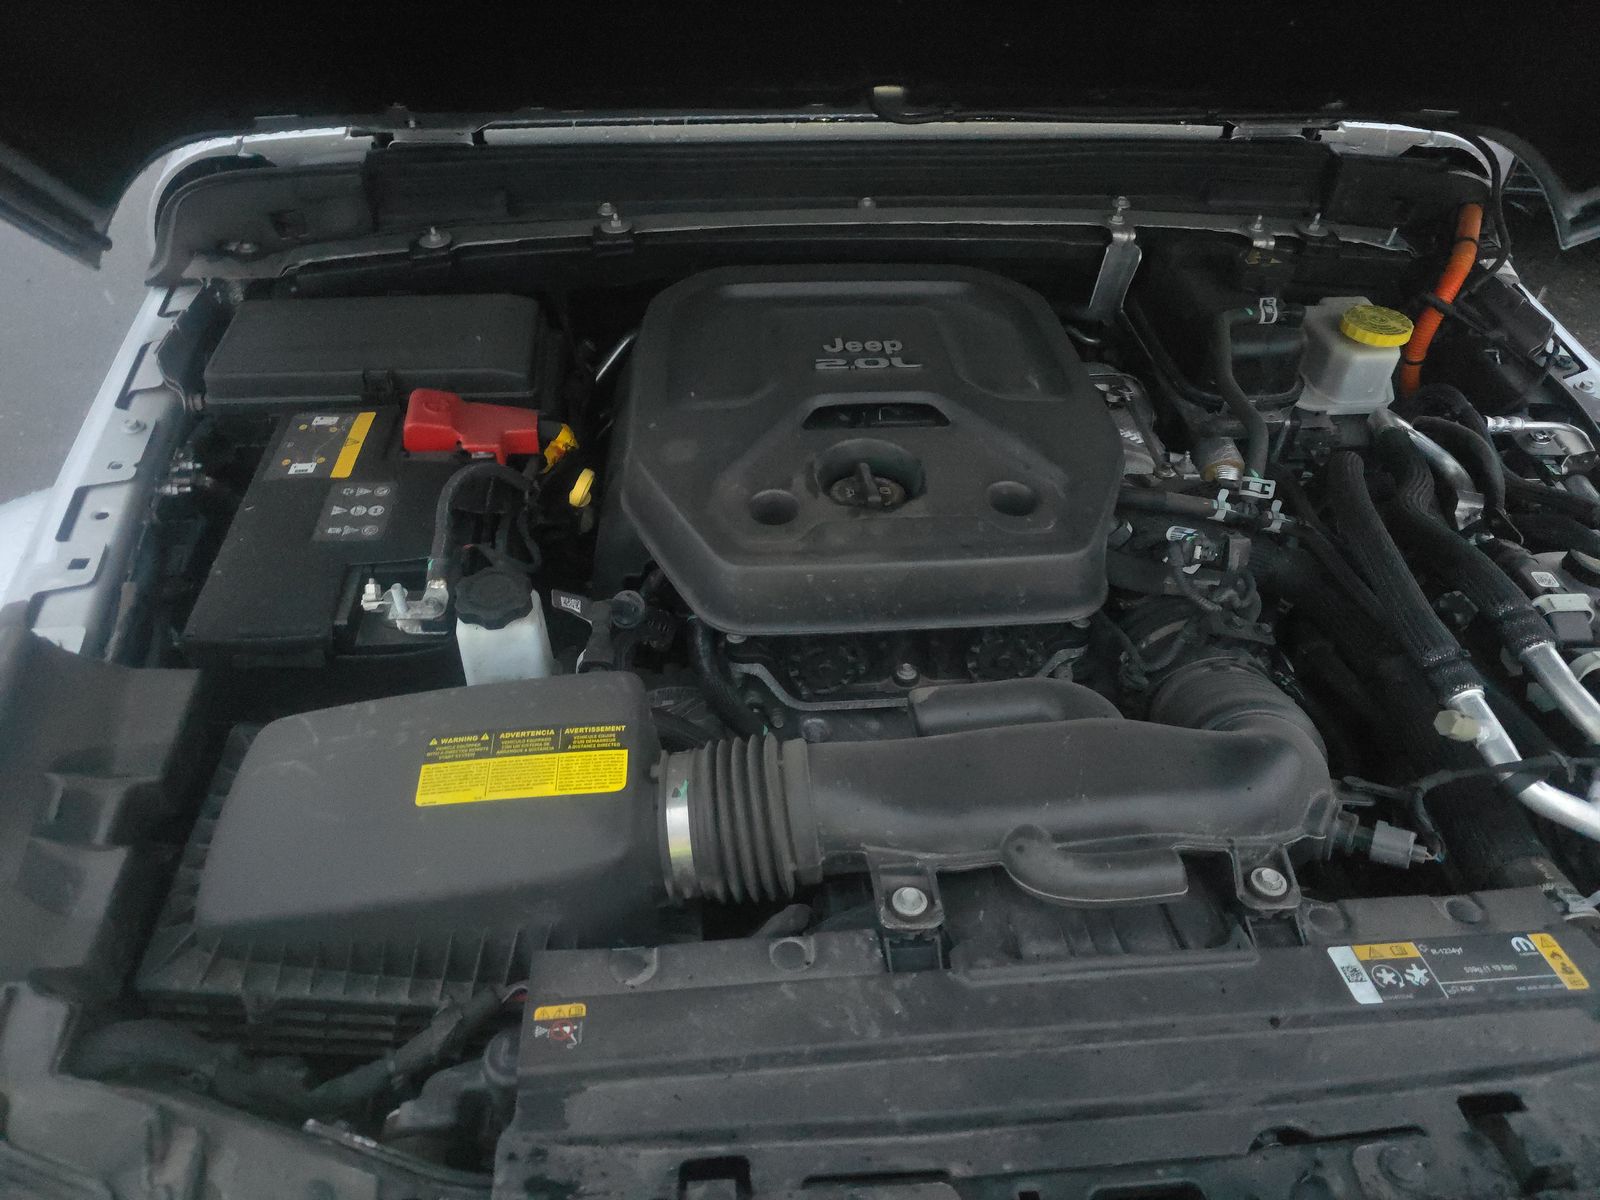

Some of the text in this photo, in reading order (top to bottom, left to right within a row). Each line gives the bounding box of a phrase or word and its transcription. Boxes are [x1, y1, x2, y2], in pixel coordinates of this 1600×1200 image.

[823, 337, 902, 354] Jeep
[815, 357, 923, 369] 2.0L
[500, 729, 555, 739] ADVERTENCIA
[564, 725, 626, 735] AVERTISSEMENT
[441, 735, 478, 744] WARNING
